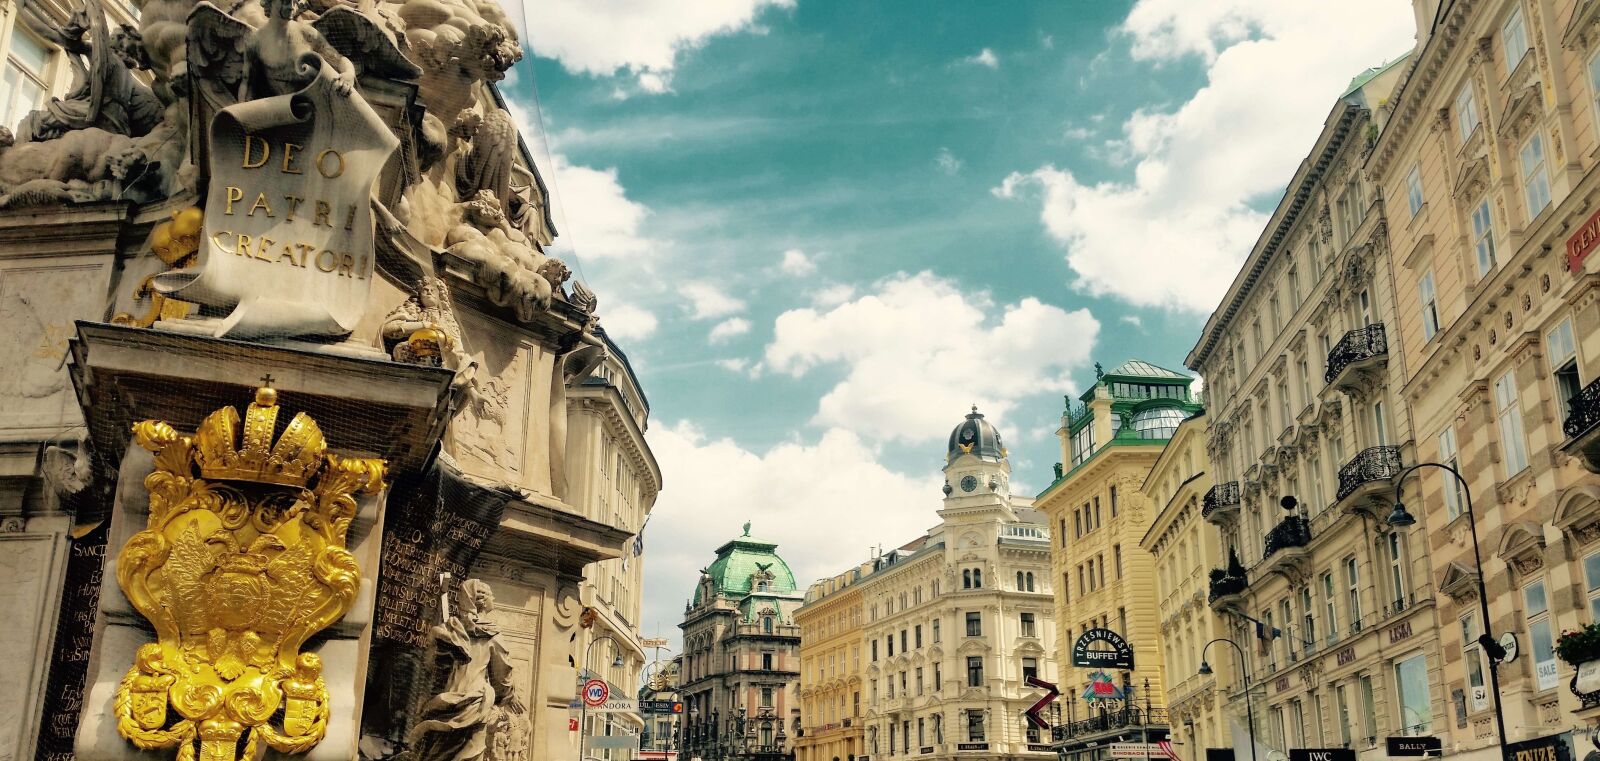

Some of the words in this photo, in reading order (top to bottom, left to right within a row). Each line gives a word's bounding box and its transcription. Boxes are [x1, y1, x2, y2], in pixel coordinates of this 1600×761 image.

[242, 135, 345, 179] DEO
[224, 186, 357, 231] PATRI
[213, 230, 368, 280] CREATORI
[1086, 651, 1118, 660] BUFFET
[1538, 663, 1556, 678] SALE
[593, 702, 632, 710] ANDORA
[1309, 752, 1332, 761] IWC
[1516, 745, 1557, 761] KNIZE
